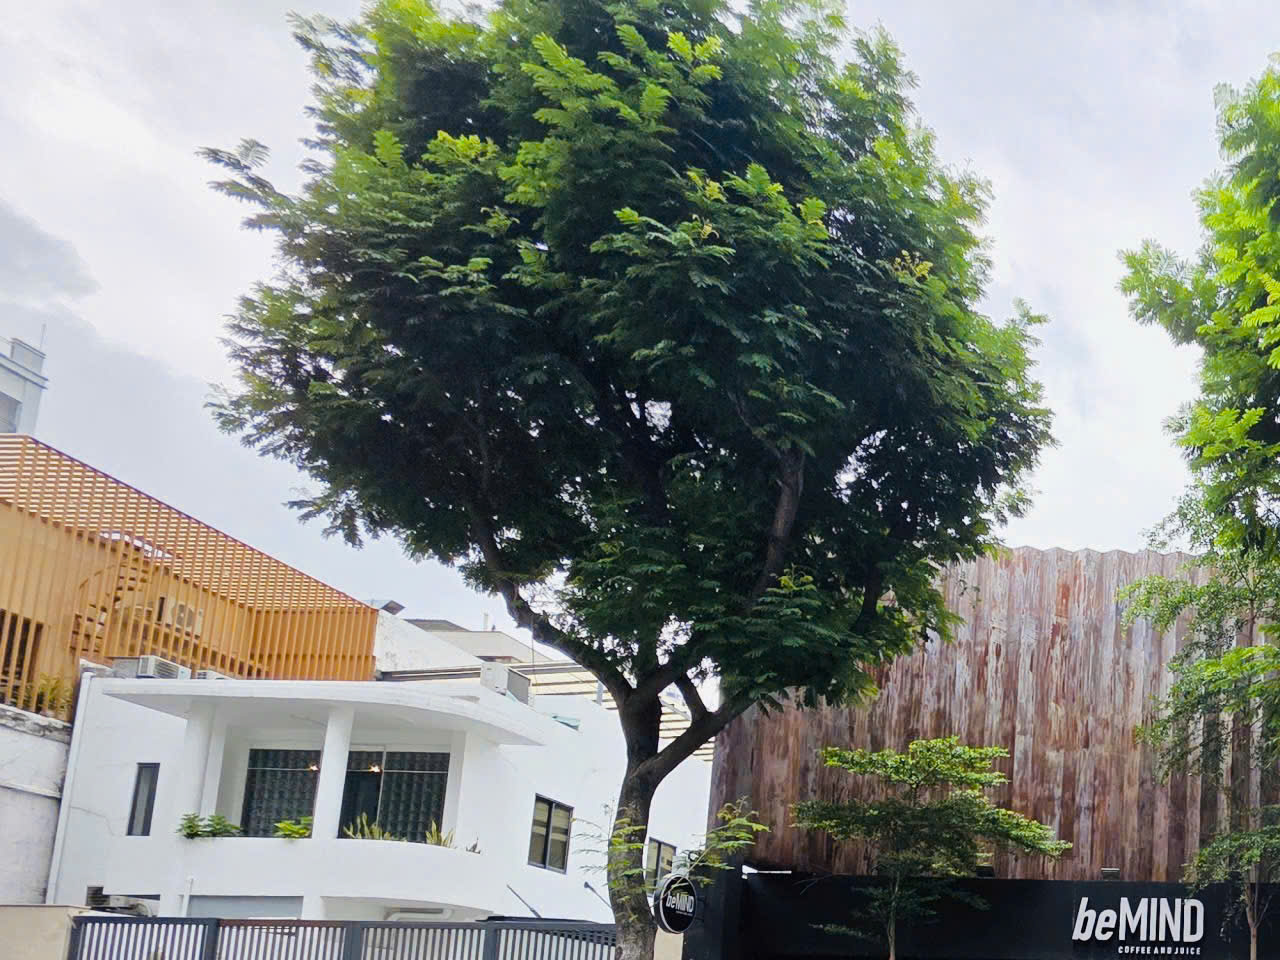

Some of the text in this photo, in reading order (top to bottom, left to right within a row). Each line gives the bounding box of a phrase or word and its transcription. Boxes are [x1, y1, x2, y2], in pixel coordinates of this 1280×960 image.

[666, 892, 695, 913] beMIND
[1071, 896, 1205, 942] beMIND
[1118, 945, 1201, 955] COFFEE AND JUICE
